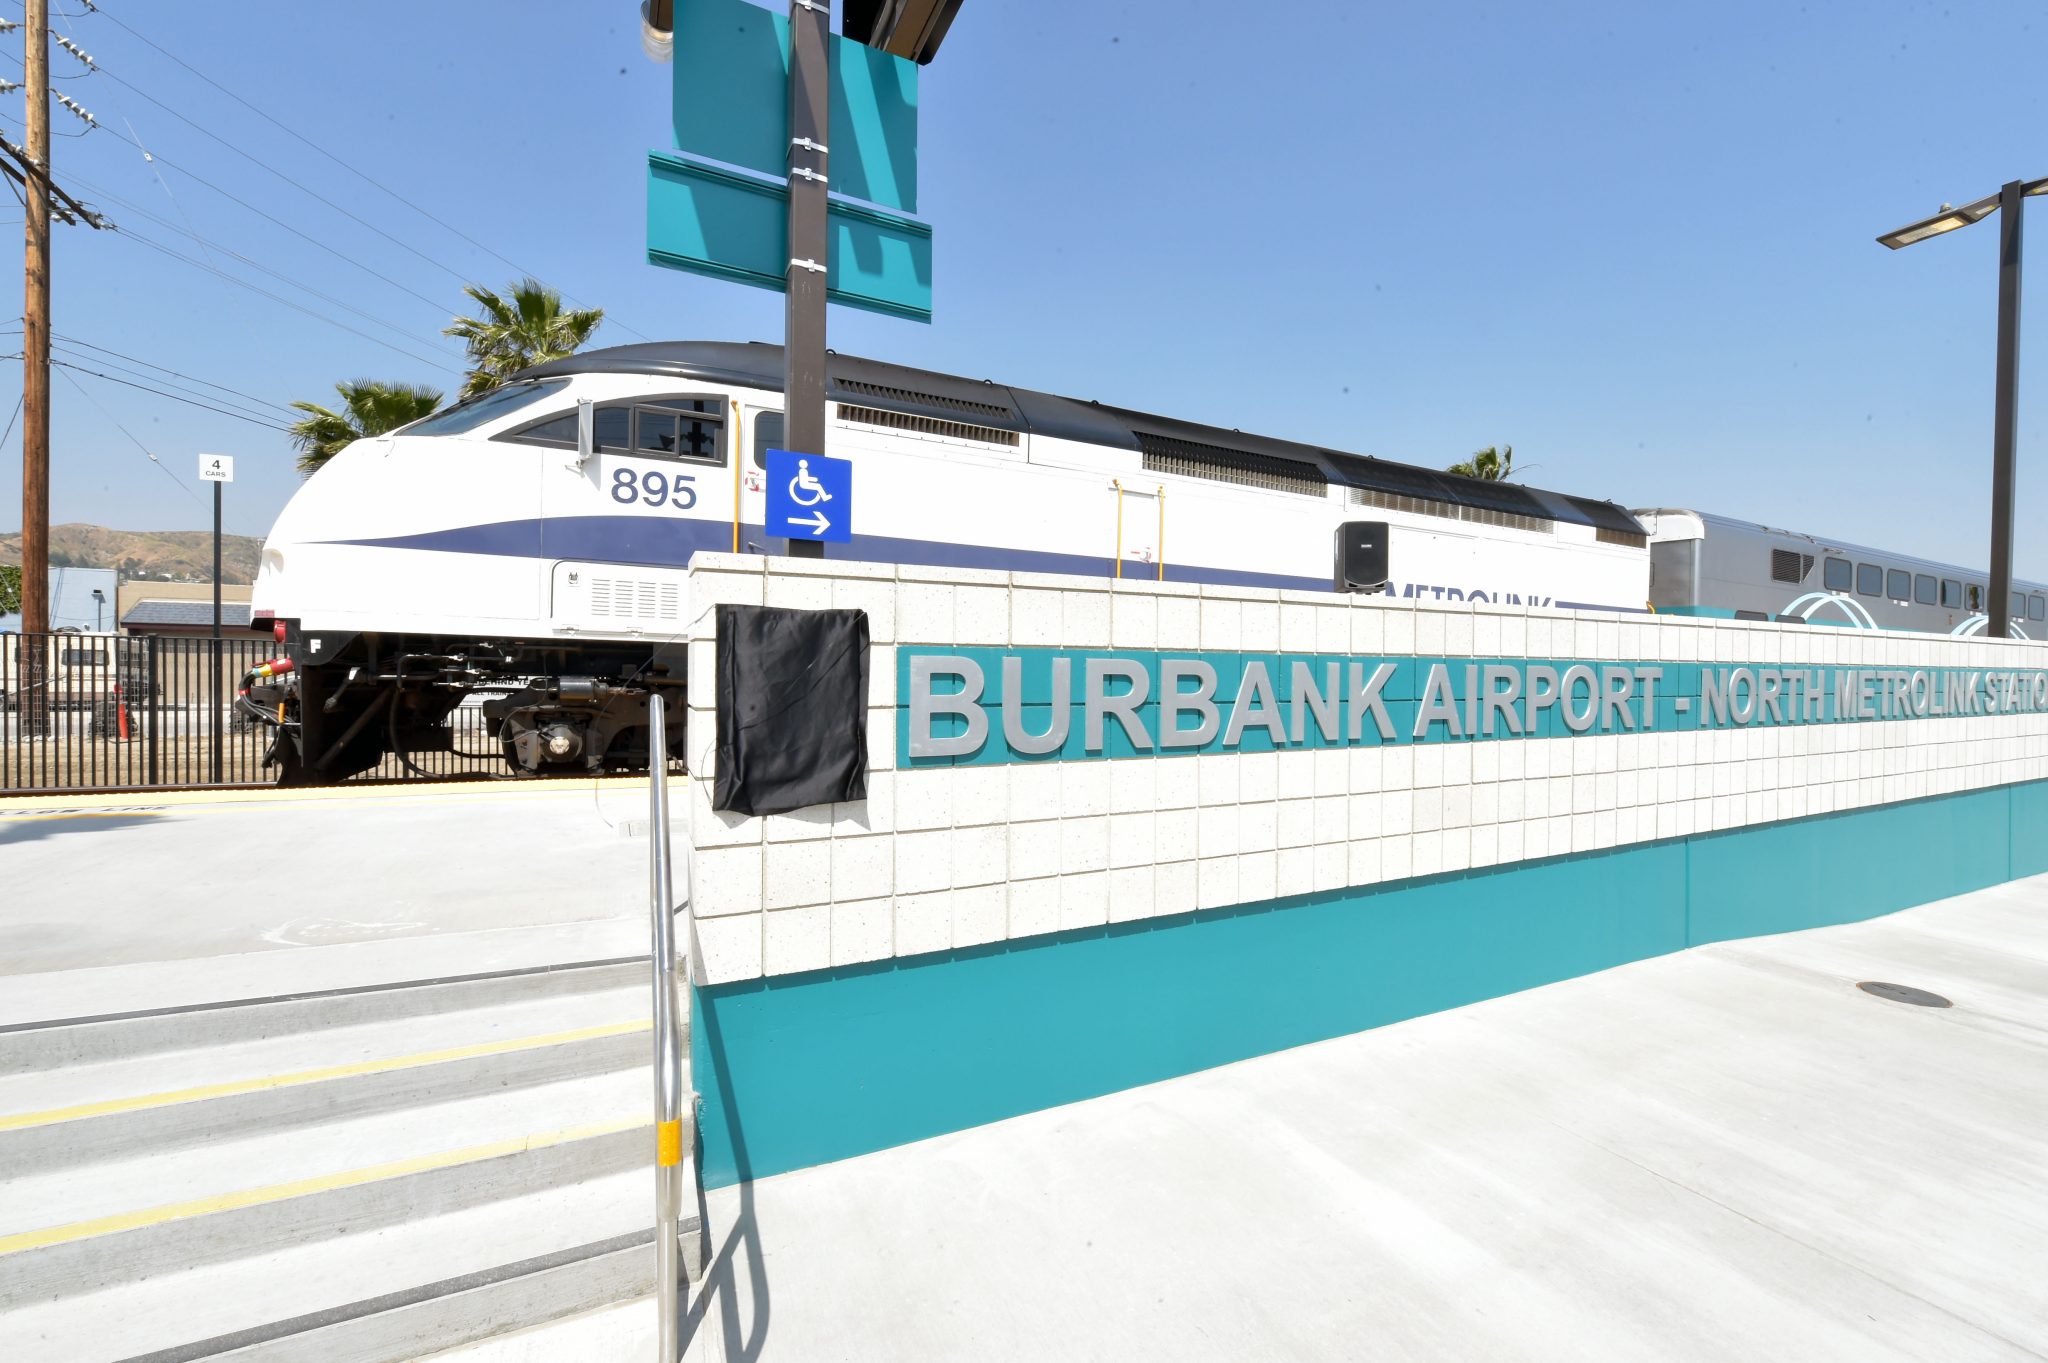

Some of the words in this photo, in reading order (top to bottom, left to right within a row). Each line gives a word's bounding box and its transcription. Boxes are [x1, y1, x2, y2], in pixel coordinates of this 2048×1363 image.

[212, 459, 221, 469] 4
[611, 467, 697, 510] 895
[310, 639, 321, 653] F
[908, 655, 1399, 758] BURBANK
[1412, 663, 1664, 737] AIRPORT
[1701, 667, 1825, 726] NORTH
[1834, 669, 1982, 719] METROLINK
